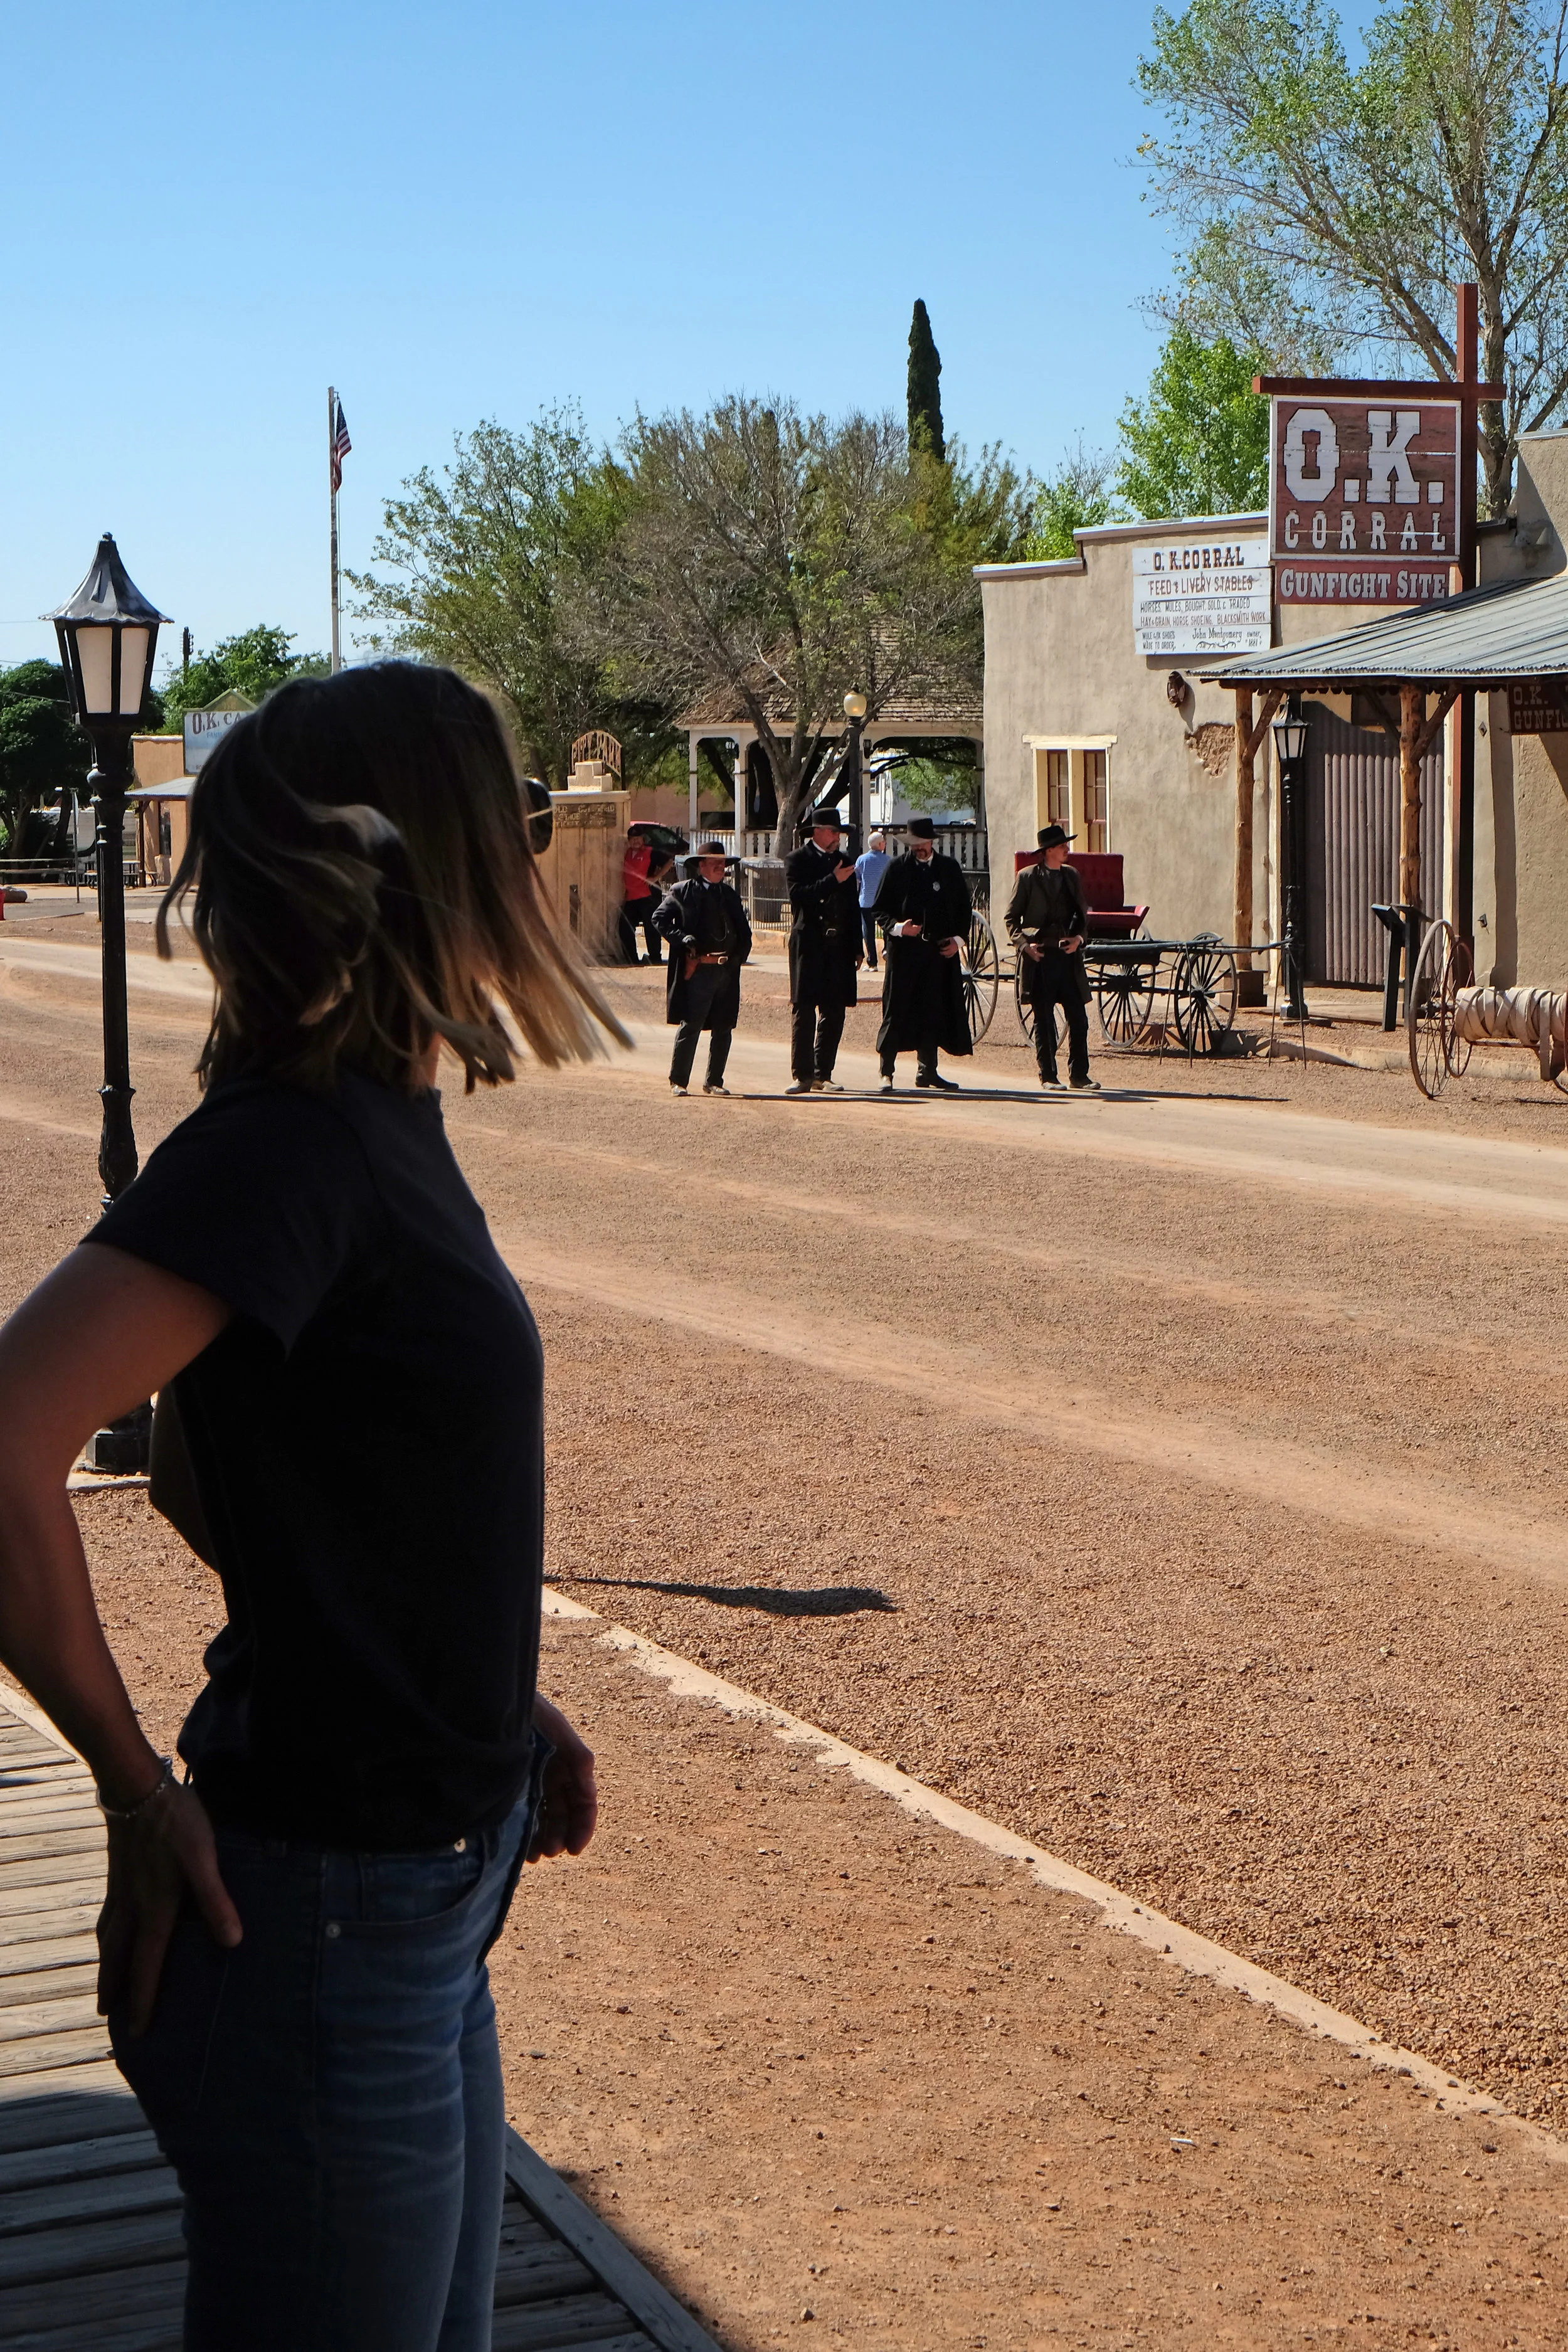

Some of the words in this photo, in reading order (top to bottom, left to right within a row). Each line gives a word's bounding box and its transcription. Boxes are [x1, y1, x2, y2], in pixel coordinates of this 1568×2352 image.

[1283, 408, 1444, 504] O.K.
[1285, 510, 1446, 551] CORRAL
[1182, 546, 1244, 569] CORRAL
[1149, 580, 1172, 596] FEED
[1182, 576, 1211, 594] LIVERY
[1214, 575, 1253, 593] STABLES
[1280, 569, 1391, 598] GUNFIGHT
[1397, 569, 1446, 599] SITE
[1229, 597, 1250, 610] TRADED
[1172, 615, 1189, 627] HORSE
[1217, 612, 1249, 625] BLACKSMITH
[1251, 611, 1266, 623] WORK
[1142, 632, 1152, 640] MULE
[1162, 630, 1175, 640] SHOES
[1192, 628, 1207, 640] John
[1209, 627, 1242, 643] Montgomery
[1143, 640, 1153, 650] MADE
[1155, 641, 1160, 649] TO
[1513, 686, 1549, 705] O.K.
